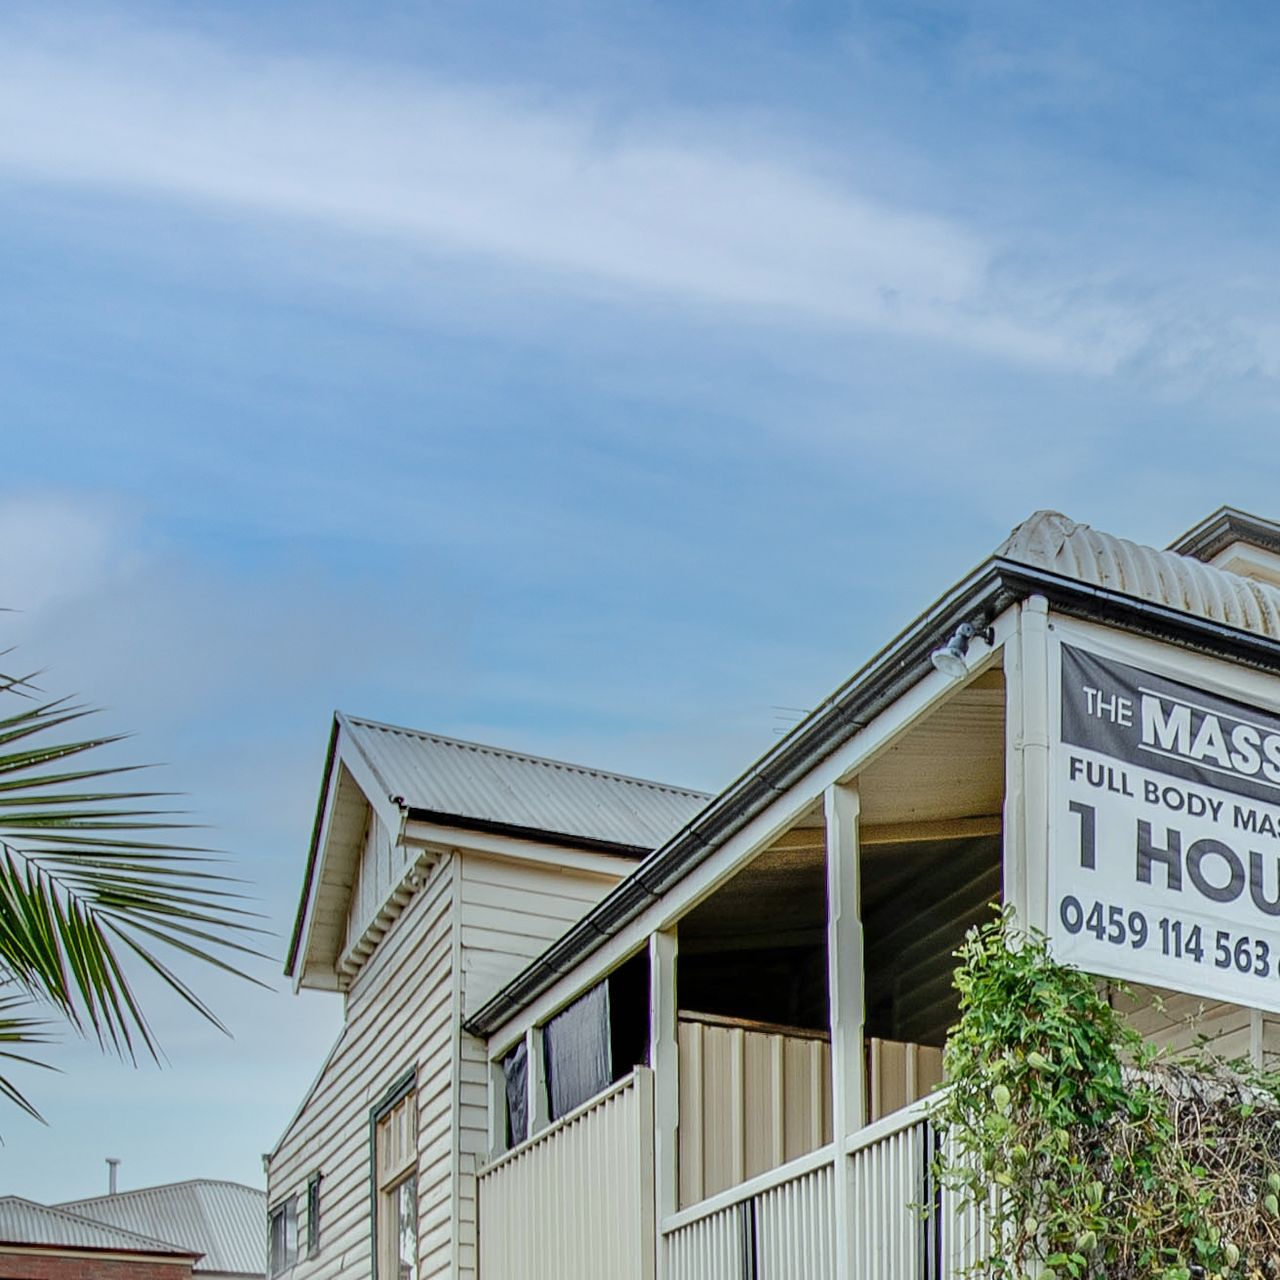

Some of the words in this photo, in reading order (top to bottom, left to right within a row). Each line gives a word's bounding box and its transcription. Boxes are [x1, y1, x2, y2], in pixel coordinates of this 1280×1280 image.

[1083, 685, 1133, 728] THE
[1069, 757, 1134, 798] FULL
[1143, 780, 1224, 823] BODY
[1069, 800, 1096, 871] 1
[1060, 895, 1148, 949] 0459
[1159, 918, 1204, 964] 114
[1215, 932, 1271, 979] 563
